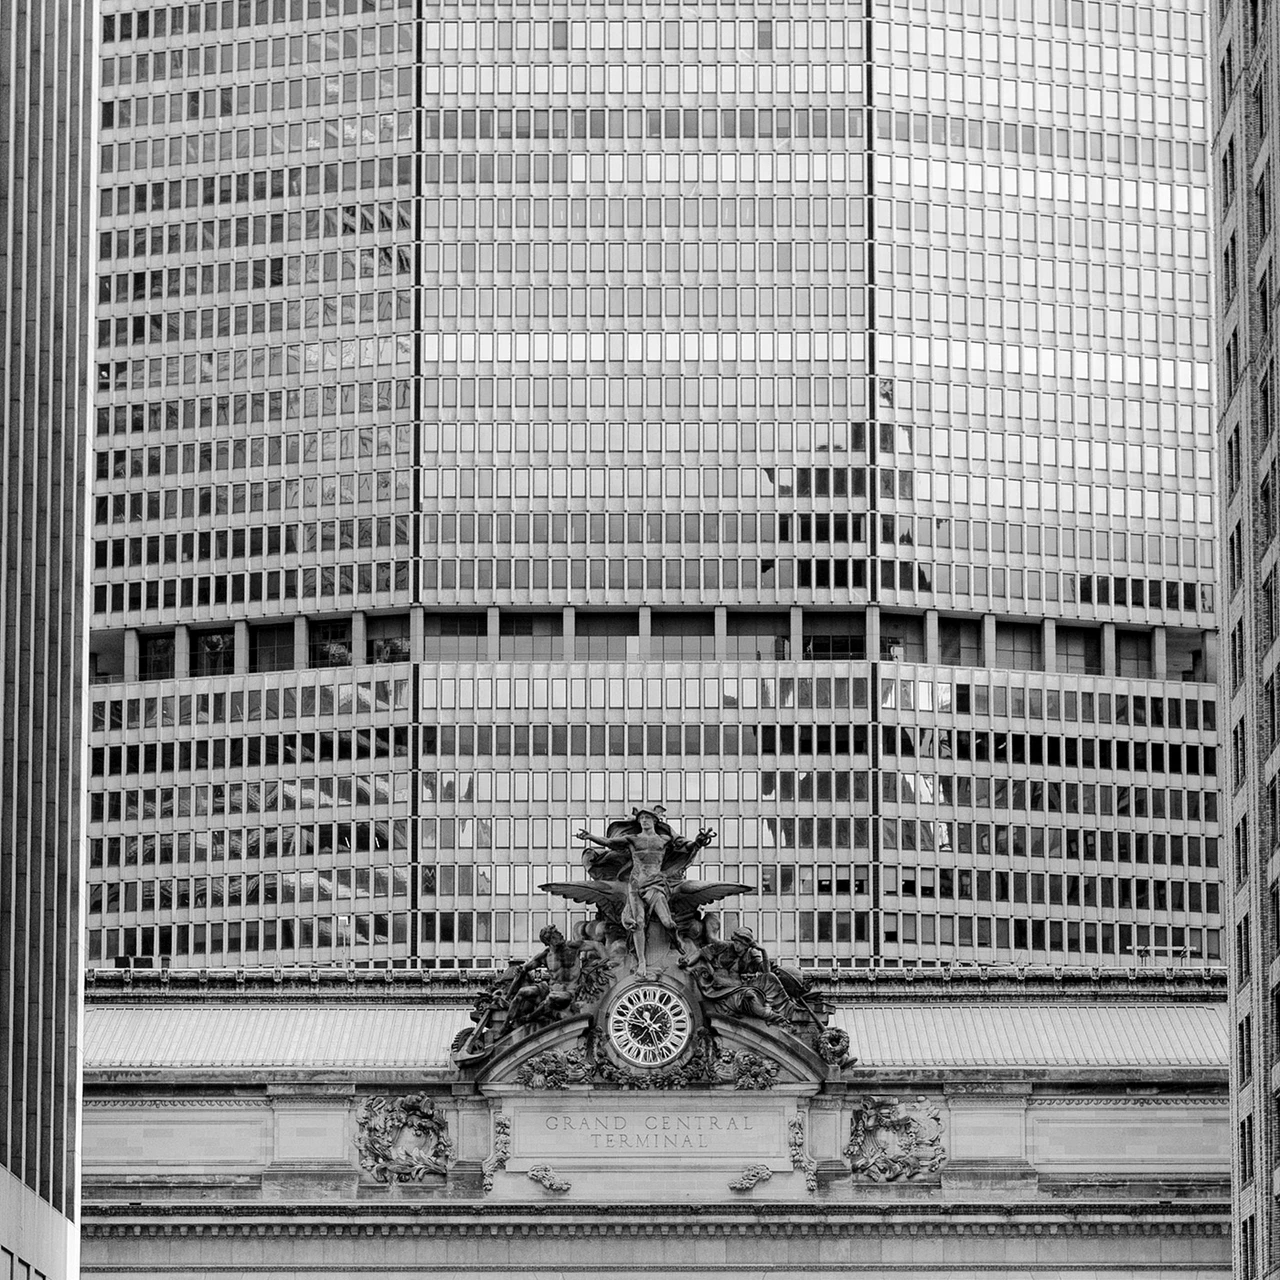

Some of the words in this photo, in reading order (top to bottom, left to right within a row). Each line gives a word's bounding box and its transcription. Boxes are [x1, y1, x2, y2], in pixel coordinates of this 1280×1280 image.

[545, 1116, 627, 1130] GRAND
[644, 1116, 754, 1130] CENTRAL
[591, 1134, 708, 1148] TERMINAL
